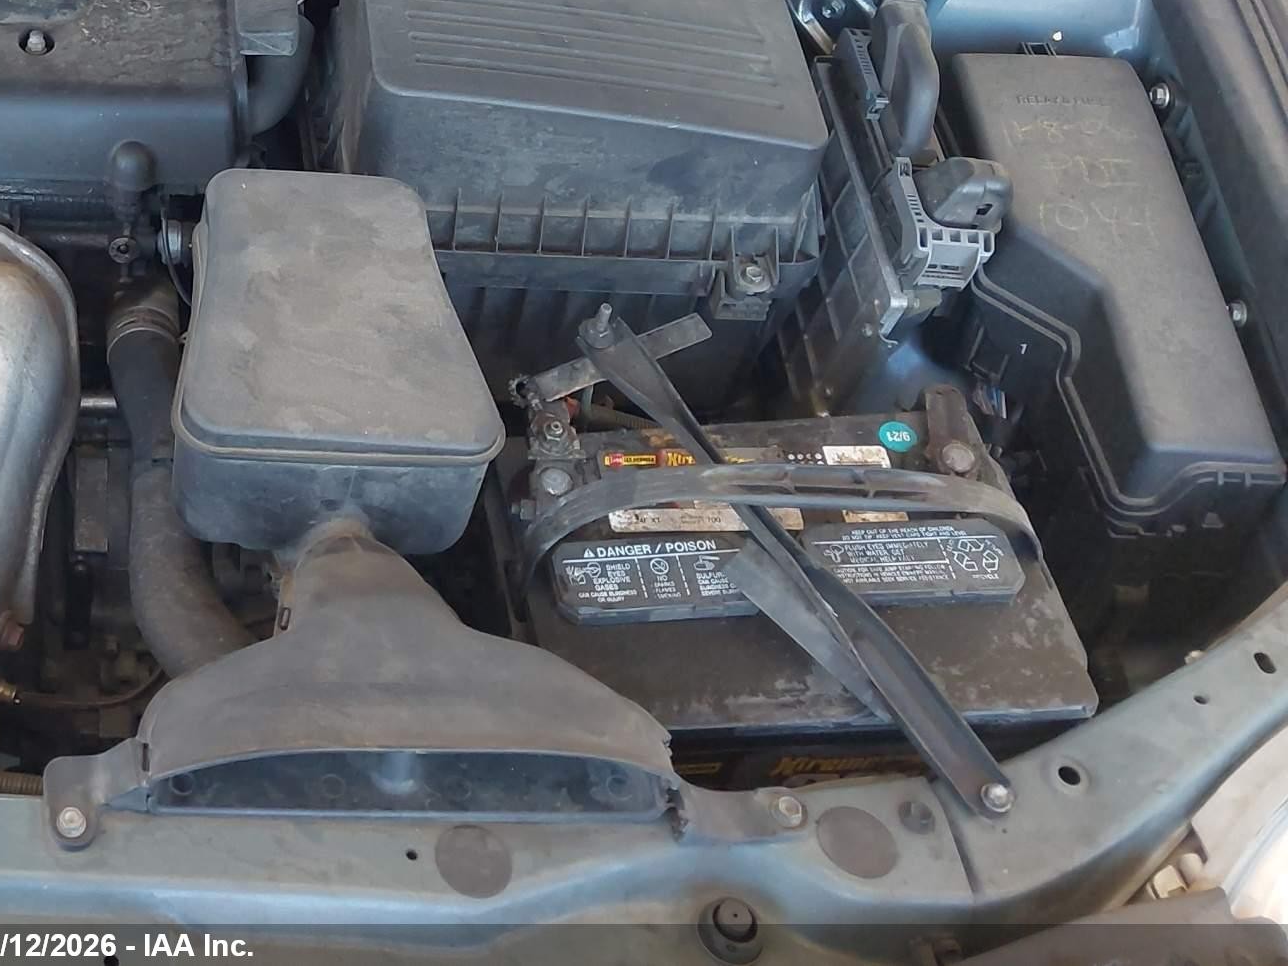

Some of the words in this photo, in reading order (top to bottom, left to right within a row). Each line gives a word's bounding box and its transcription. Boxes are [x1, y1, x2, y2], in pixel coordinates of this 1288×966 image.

[596, 542, 652, 558] DANGER
[666, 540, 717, 553] POISON
[605, 563, 631, 571] SHIELD
[593, 576, 632, 584] EXPLOSIVE
[594, 583, 619, 591] GASES
[590, 590, 608, 598] CAUSE
